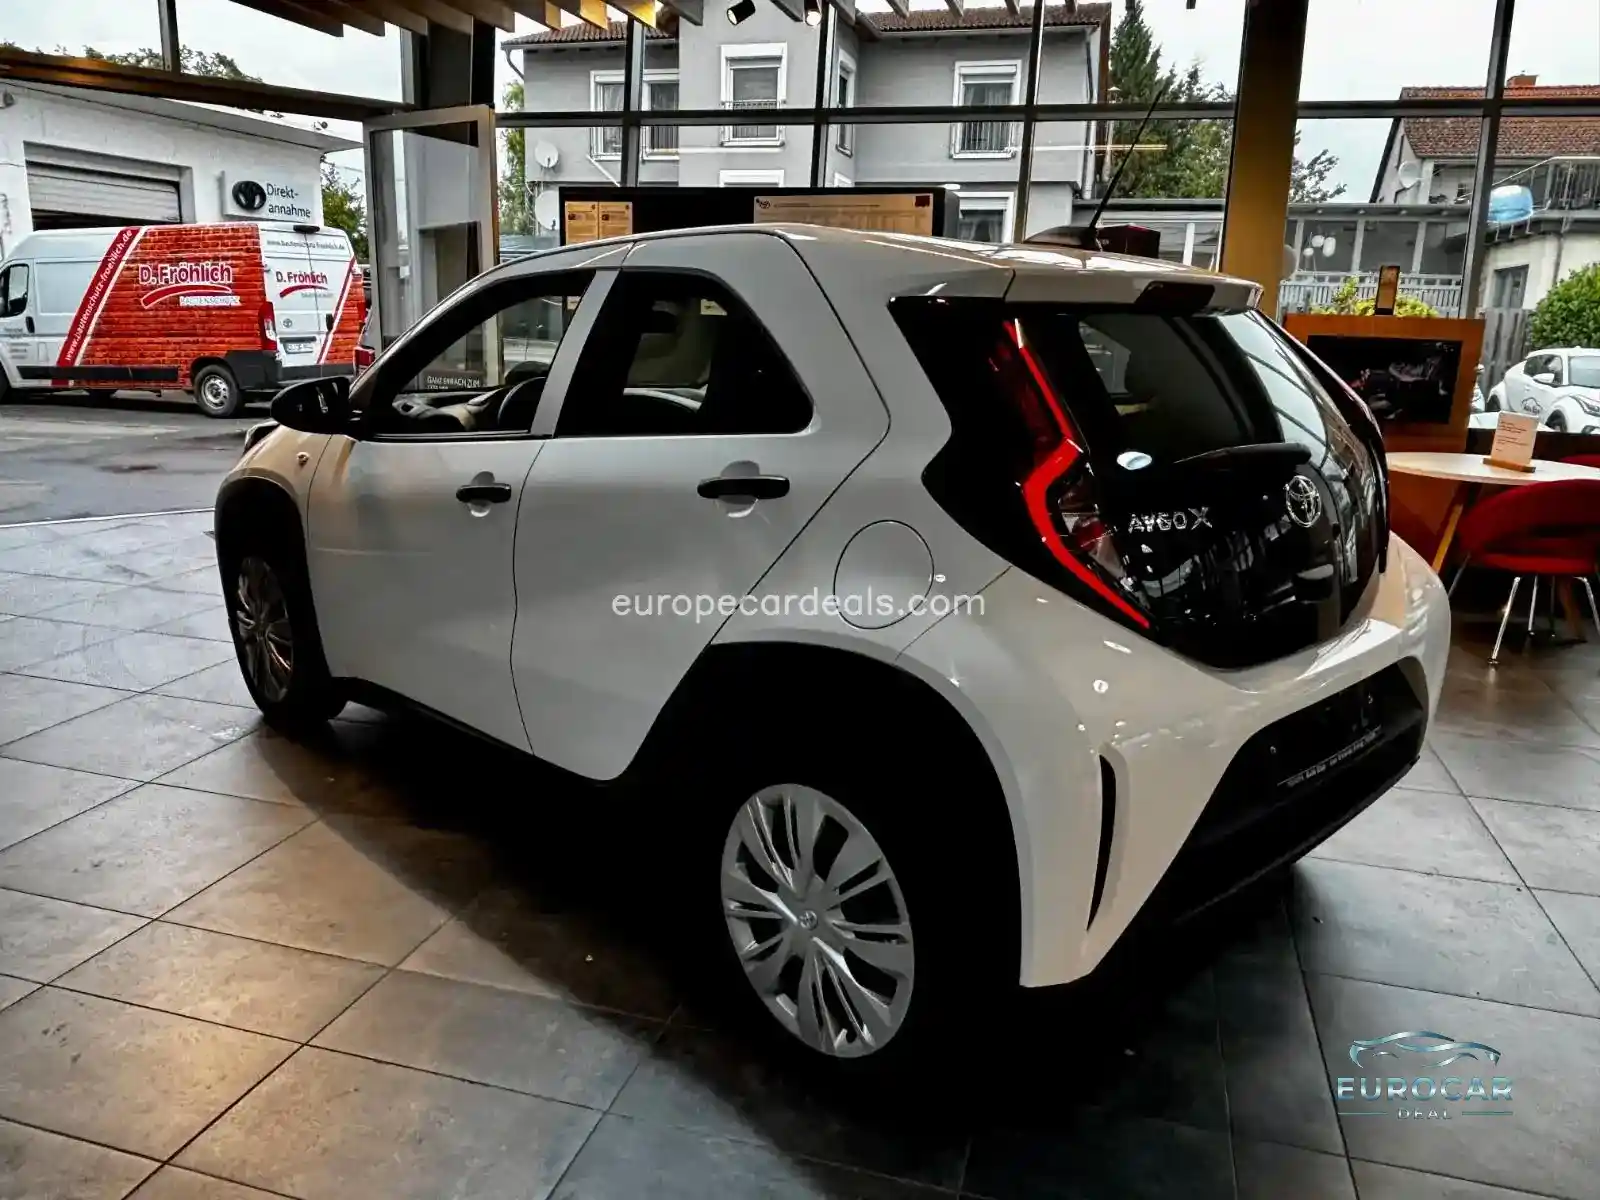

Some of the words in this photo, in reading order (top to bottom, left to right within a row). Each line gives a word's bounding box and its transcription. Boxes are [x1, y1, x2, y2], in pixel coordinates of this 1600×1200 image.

[266, 182, 299, 199] Direkt-
[268, 203, 311, 218] annahme
[158, 261, 233, 284] Fröhlich
[1127, 511, 1188, 534] AYGO
[1187, 506, 1213, 531] X
